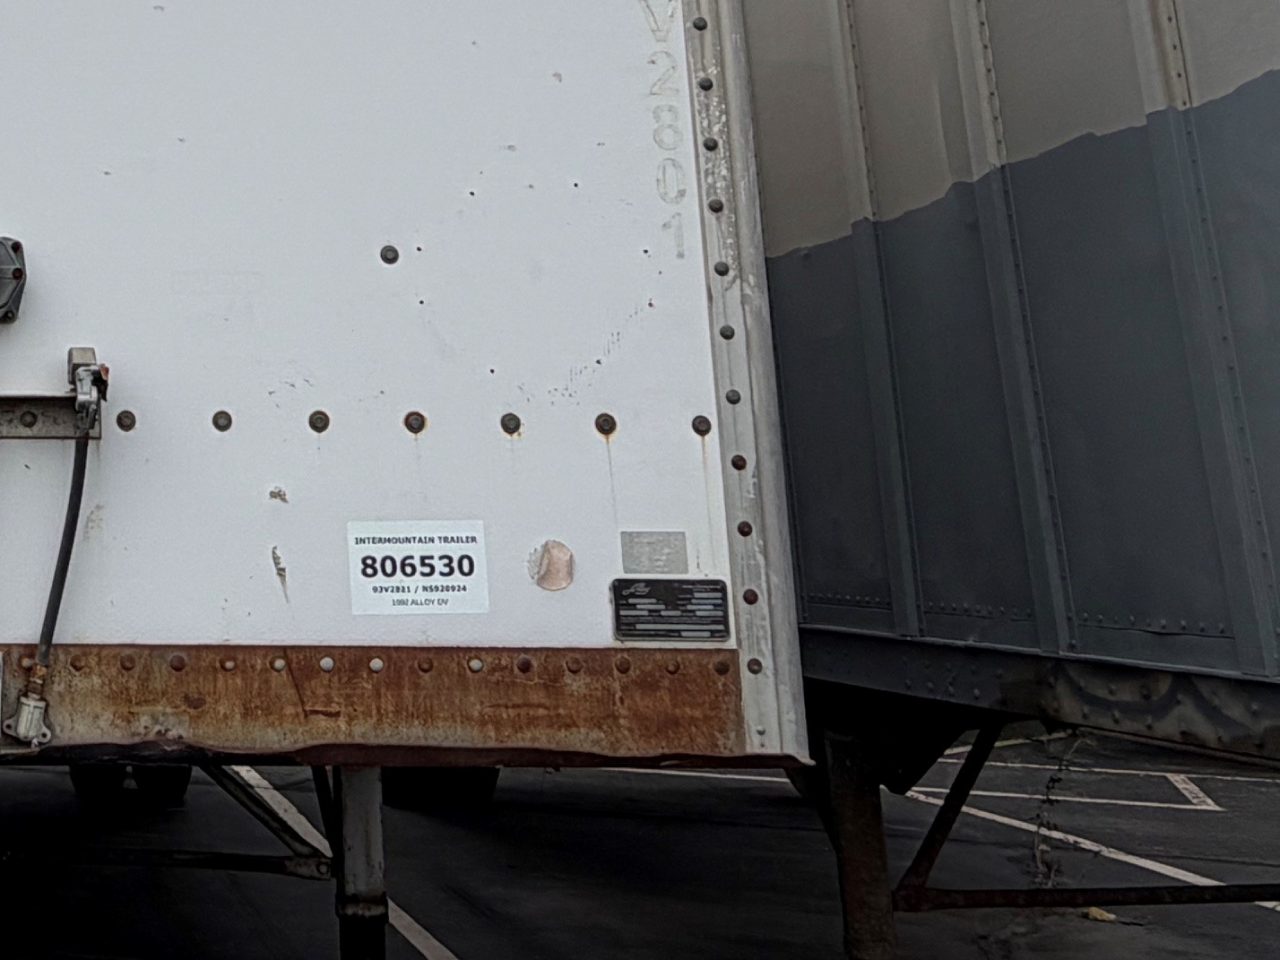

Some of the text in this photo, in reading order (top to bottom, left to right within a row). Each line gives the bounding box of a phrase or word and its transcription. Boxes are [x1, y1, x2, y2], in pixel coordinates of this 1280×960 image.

[354, 535, 478, 545] INTERMOUNTAIN TRAILER
[360, 554, 475, 578] 806530
